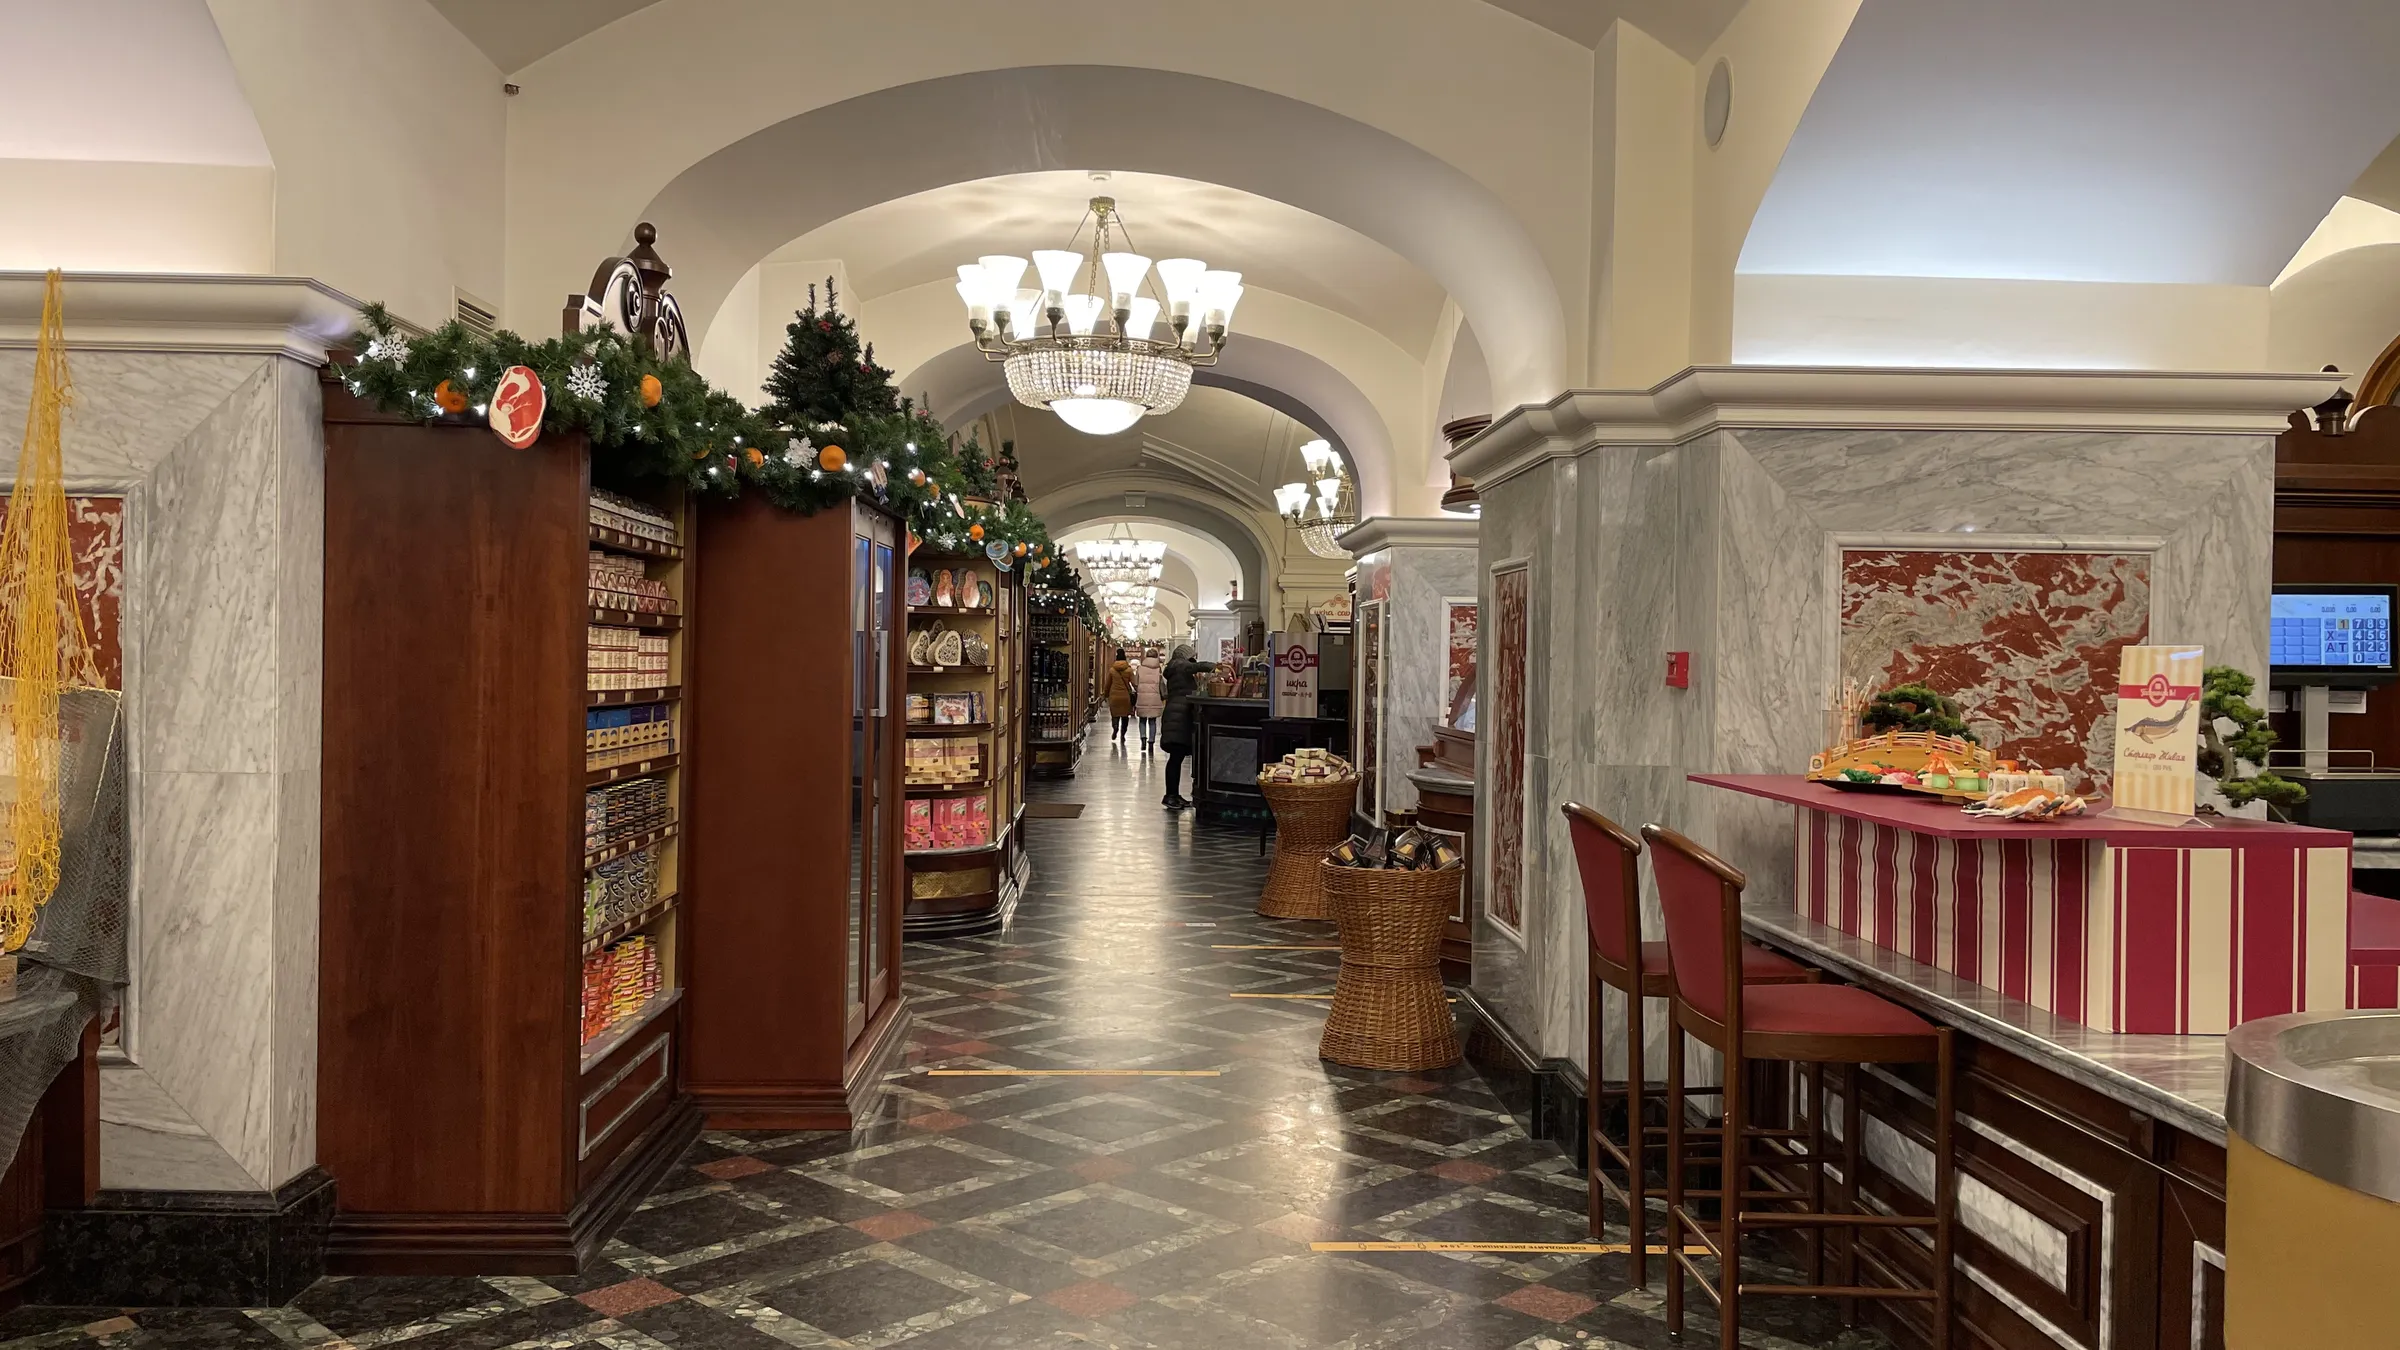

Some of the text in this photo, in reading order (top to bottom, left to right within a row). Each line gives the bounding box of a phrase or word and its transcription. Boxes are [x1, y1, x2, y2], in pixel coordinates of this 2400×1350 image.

[2355, 619, 2386, 628] 7 8 9
[2355, 630, 2362, 639] 4
[2367, 630, 2374, 639] 5
[2379, 630, 2386, 639] 6
[2355, 642, 2386, 651] 1 2 3
[2355, 654, 2361, 662] 0
[1286, 678, 1308, 691] икра
